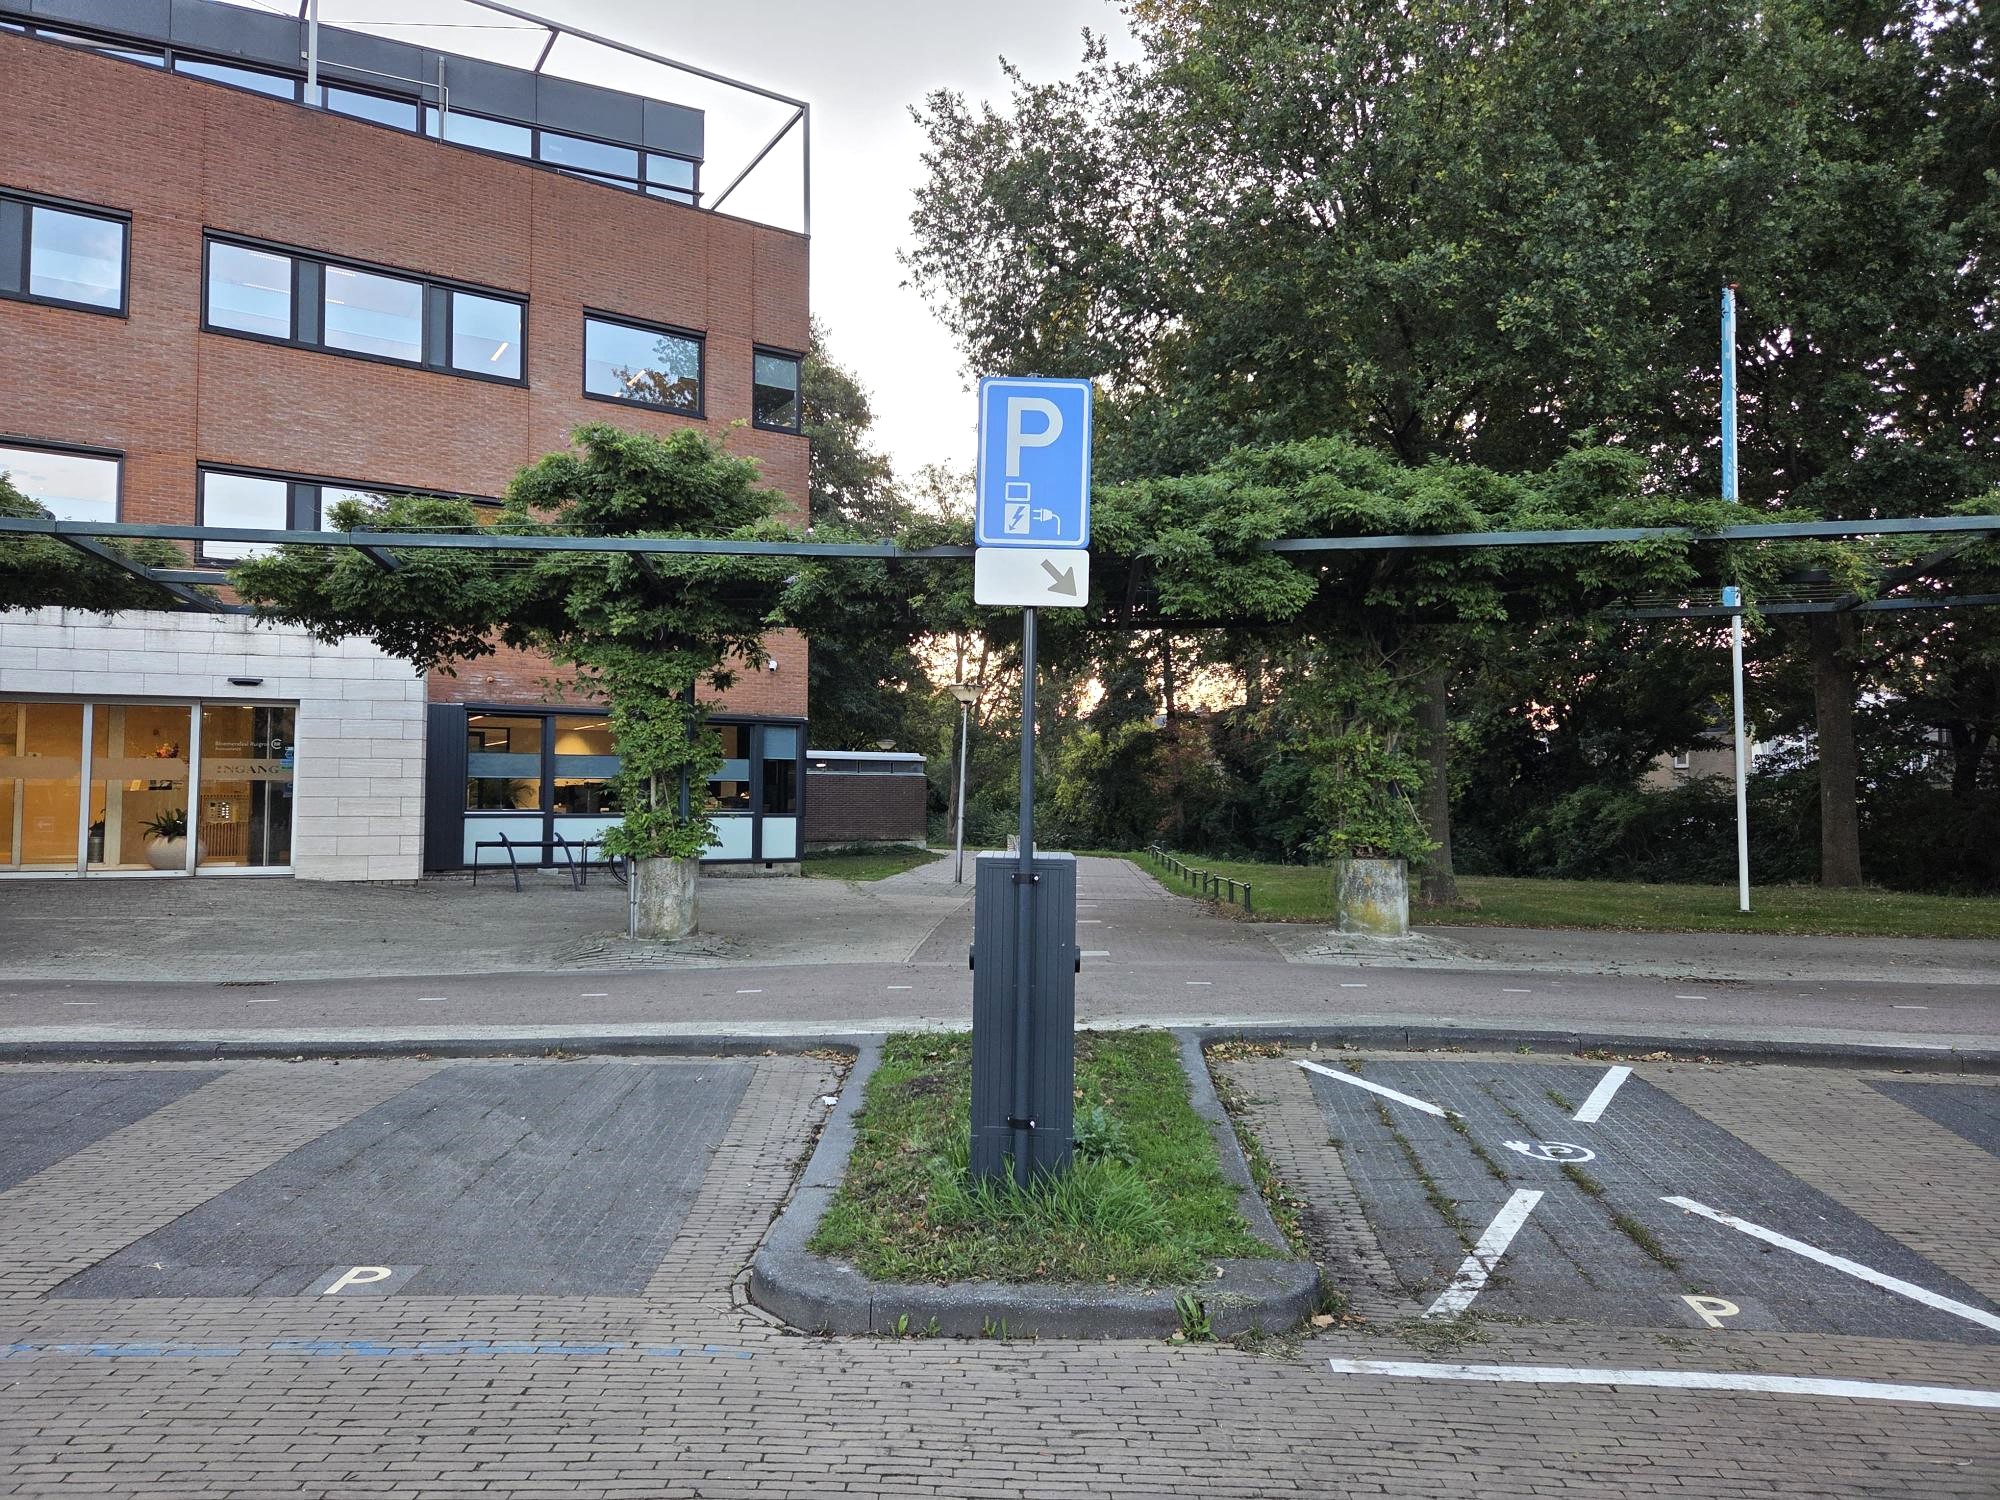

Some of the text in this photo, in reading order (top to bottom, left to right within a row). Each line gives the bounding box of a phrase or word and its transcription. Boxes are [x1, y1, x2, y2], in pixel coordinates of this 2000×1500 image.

[1006, 397, 1063, 477] P
[323, 1266, 392, 1294] P
[1680, 1295, 1740, 1328] P
